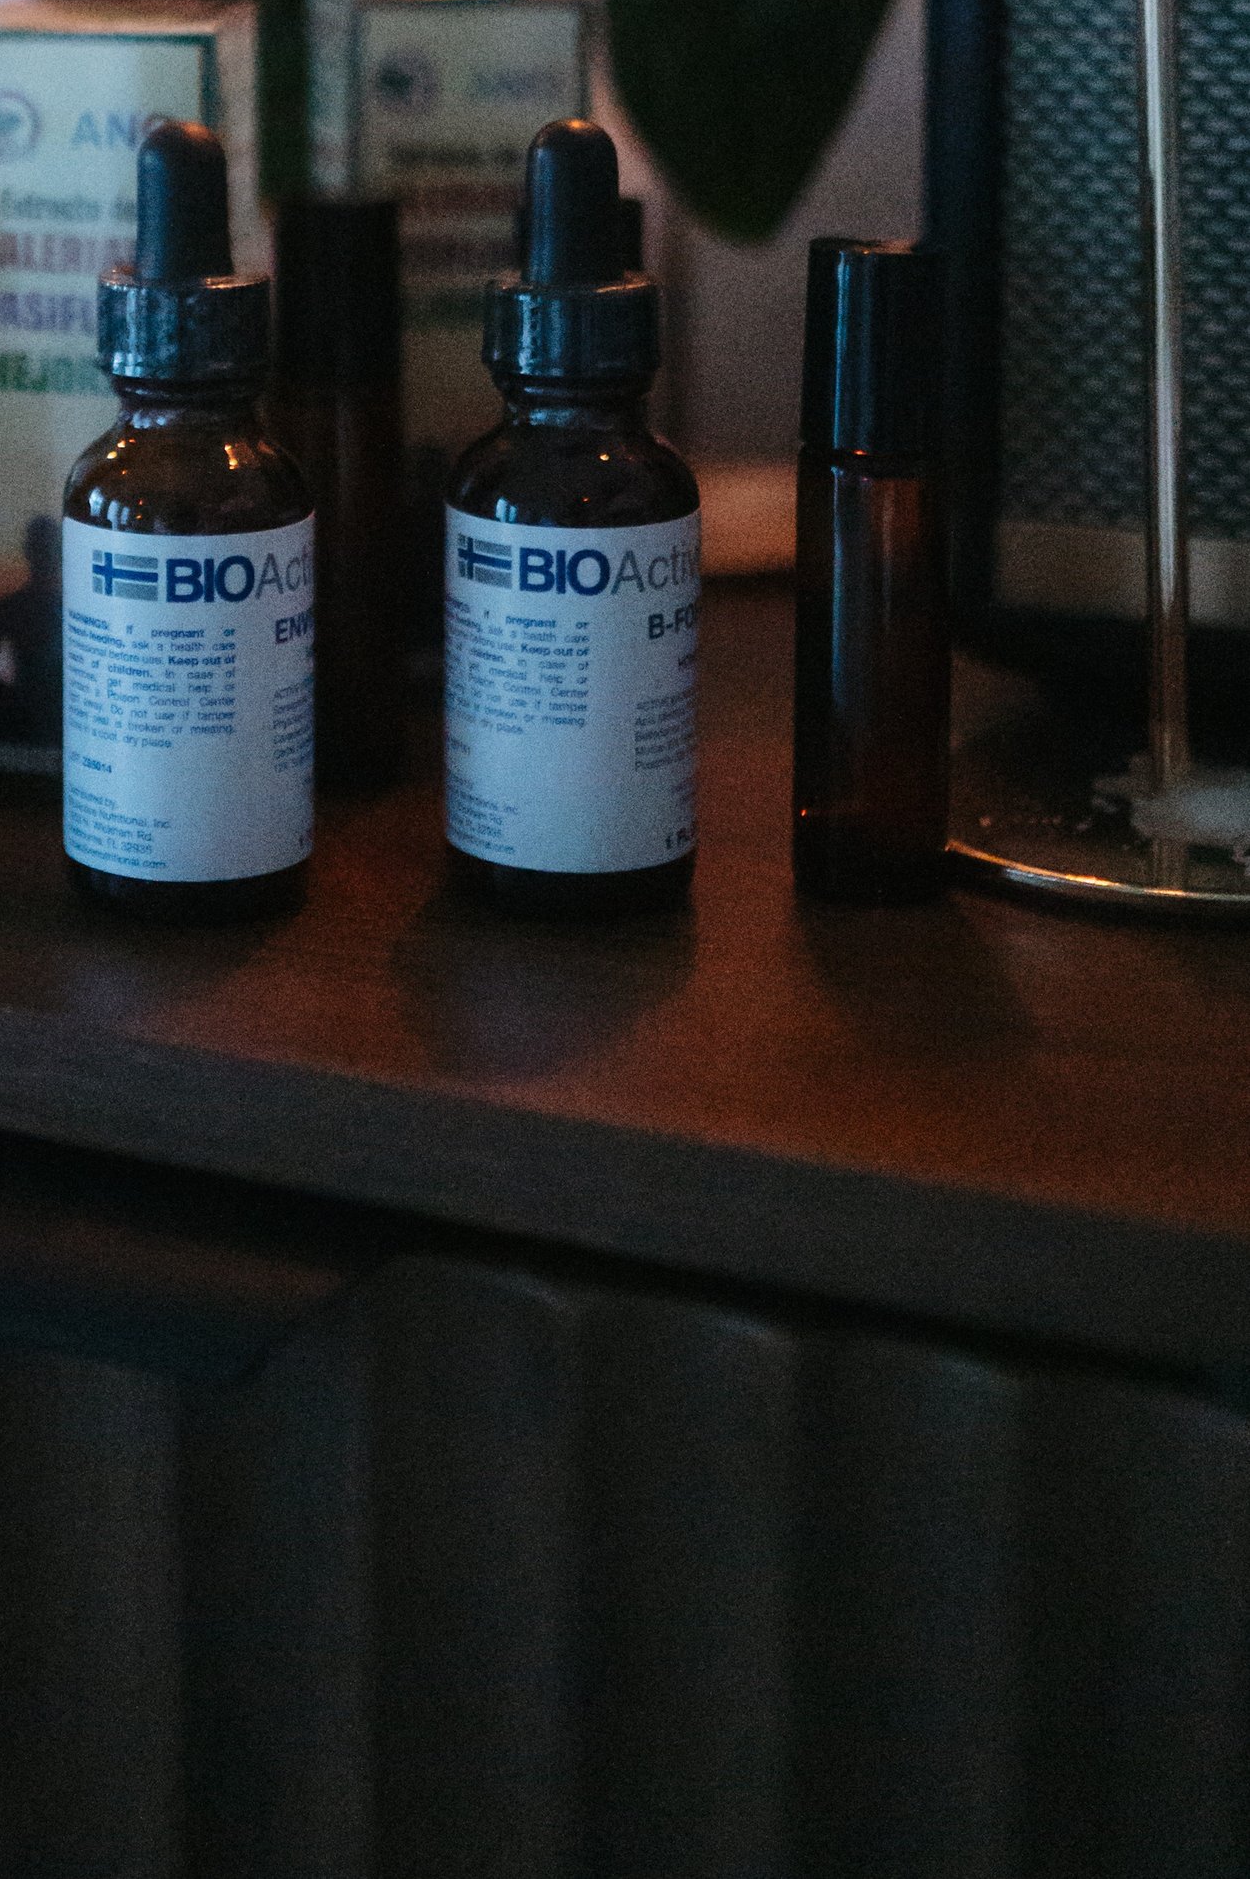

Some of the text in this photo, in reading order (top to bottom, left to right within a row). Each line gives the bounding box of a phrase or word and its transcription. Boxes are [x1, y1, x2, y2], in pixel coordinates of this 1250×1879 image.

[505, 614, 557, 630] pregnant
[150, 628, 205, 640] pregnant
[521, 642, 551, 658] Keep
[553, 646, 573, 657] out
[575, 645, 591, 657] of
[168, 655, 199, 668] Keep
[201, 655, 222, 666] out
[224, 653, 237, 666] of
[107, 663, 154, 679] children.
[148, 694, 190, 708] Control
[198, 695, 237, 708] Center
